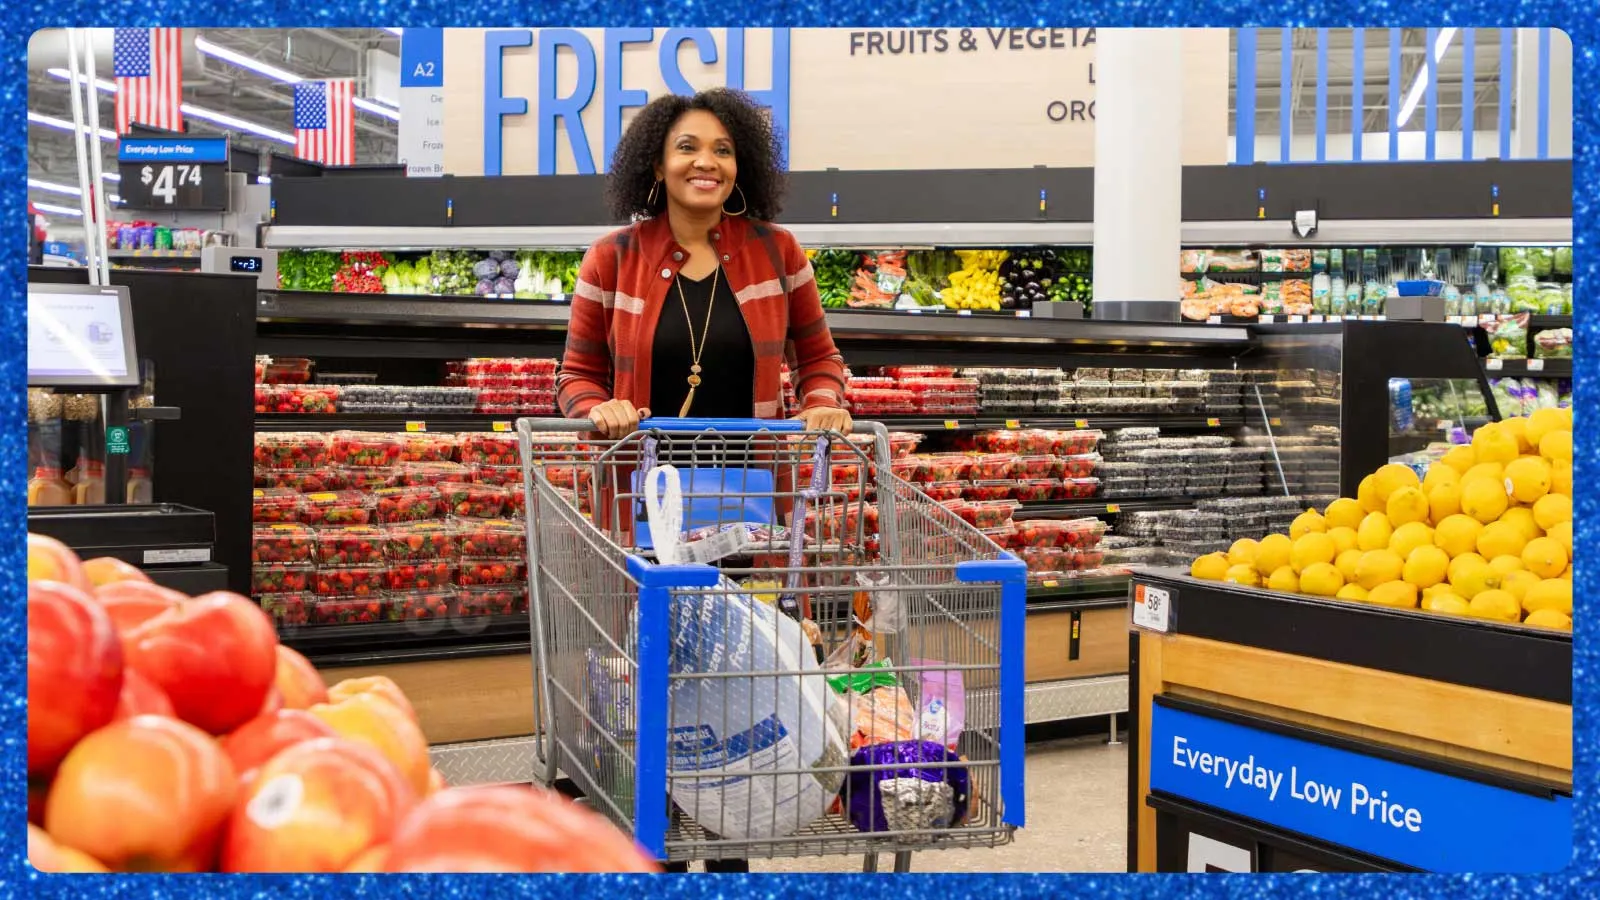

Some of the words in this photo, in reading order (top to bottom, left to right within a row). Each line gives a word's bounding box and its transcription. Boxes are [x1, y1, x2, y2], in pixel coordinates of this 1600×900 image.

[850, 29, 948, 56] FRUITS
[958, 28, 978, 52] &
[413, 62, 435, 77] A2
[125, 145, 158, 155] Everyday
[159, 145, 175, 153] Low
[175, 145, 195, 154] Price
[1173, 735, 1283, 800] Everyday
[1291, 766, 1341, 810] Low
[1351, 783, 1422, 833] Price
